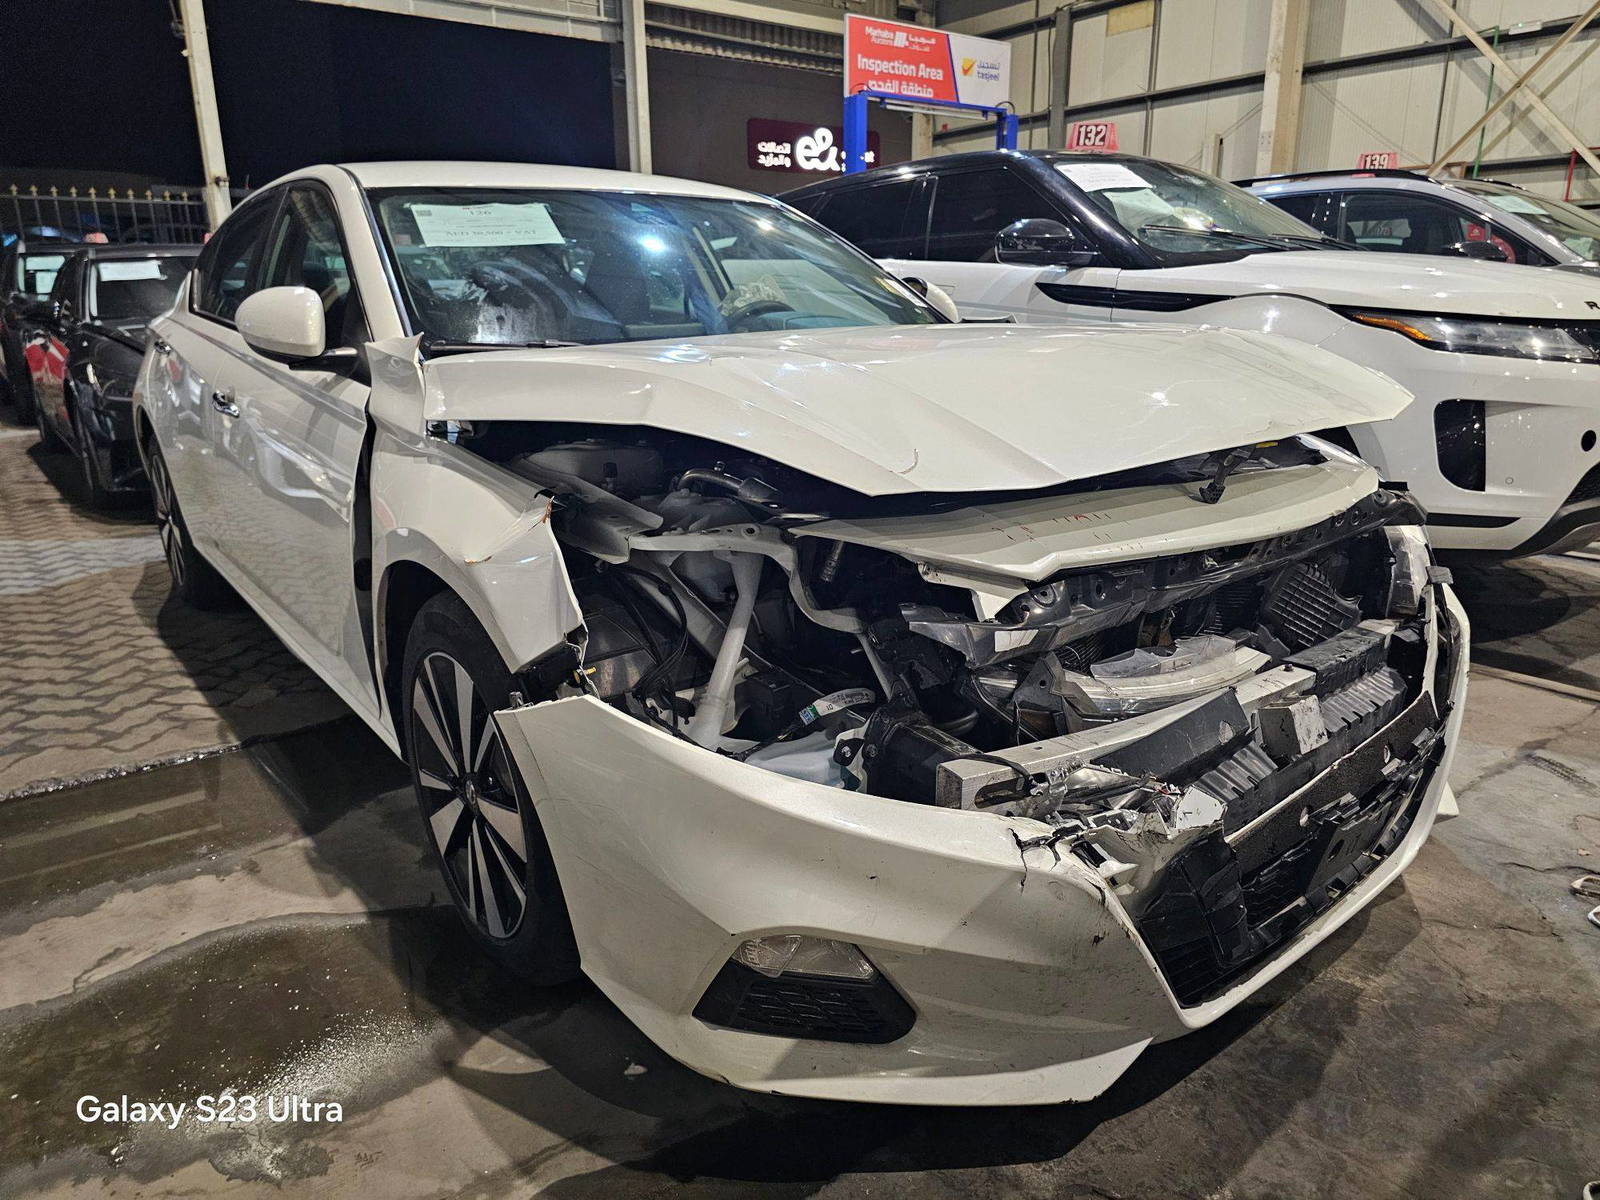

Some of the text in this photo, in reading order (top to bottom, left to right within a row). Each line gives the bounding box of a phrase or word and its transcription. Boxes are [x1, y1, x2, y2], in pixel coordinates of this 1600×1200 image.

[857, 54, 943, 80] Inspection Area
[901, 81, 934, 98] منطقة
[1079, 125, 1107, 146] 132
[1365, 154, 1389, 169] 139
